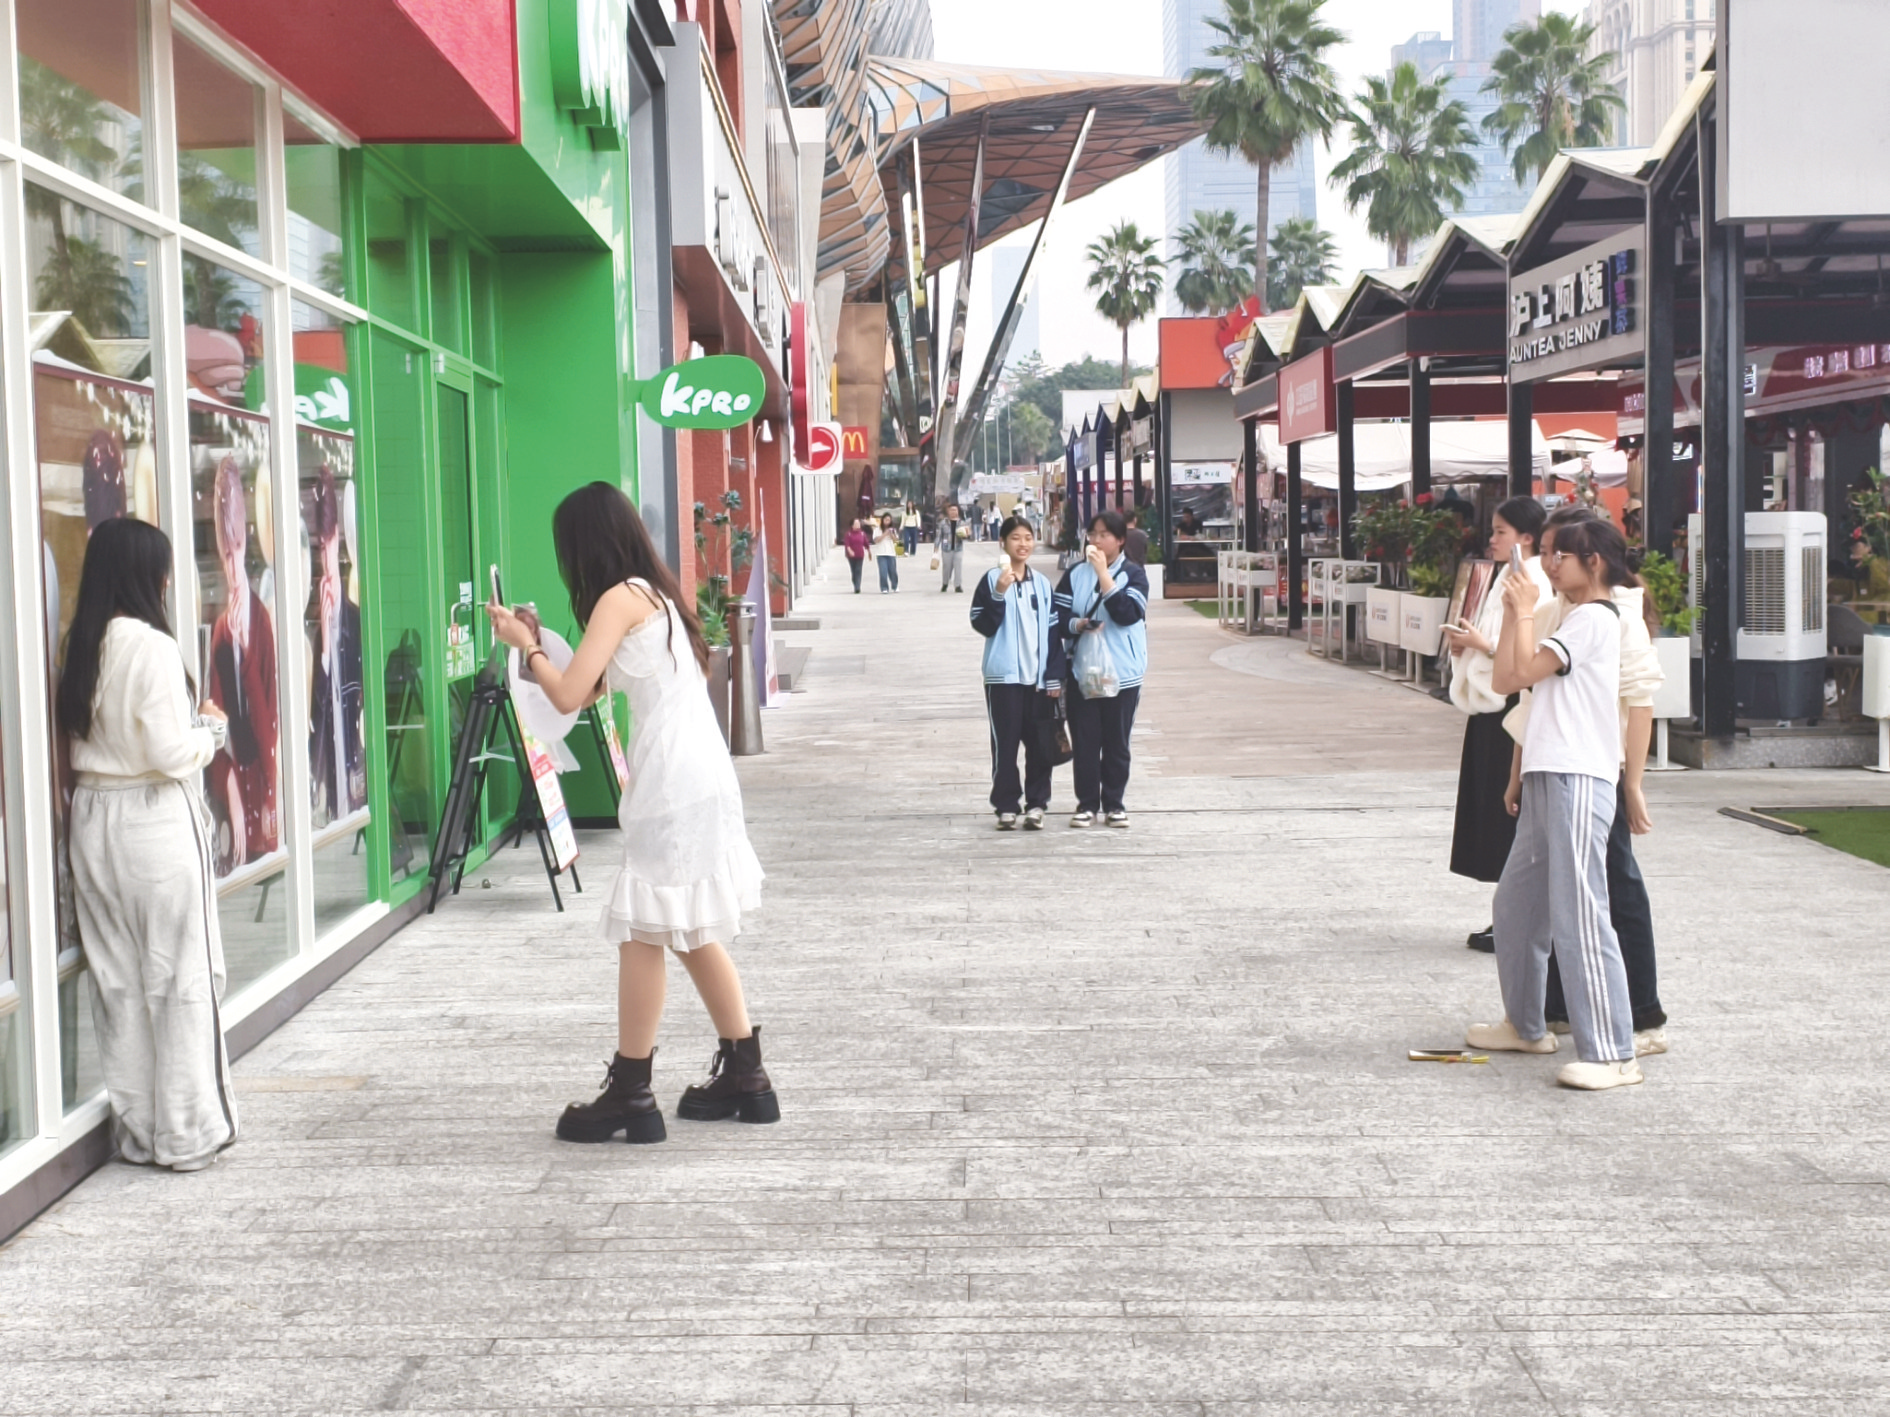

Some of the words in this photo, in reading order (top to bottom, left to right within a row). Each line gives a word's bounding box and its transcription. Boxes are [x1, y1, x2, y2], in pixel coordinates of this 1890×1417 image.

[1510, 259, 1605, 337] 沪上阿姨
[1509, 335, 1556, 364] AUNTEA
[1558, 319, 1602, 351] JENNY
[660, 371, 752, 418] KPRO
